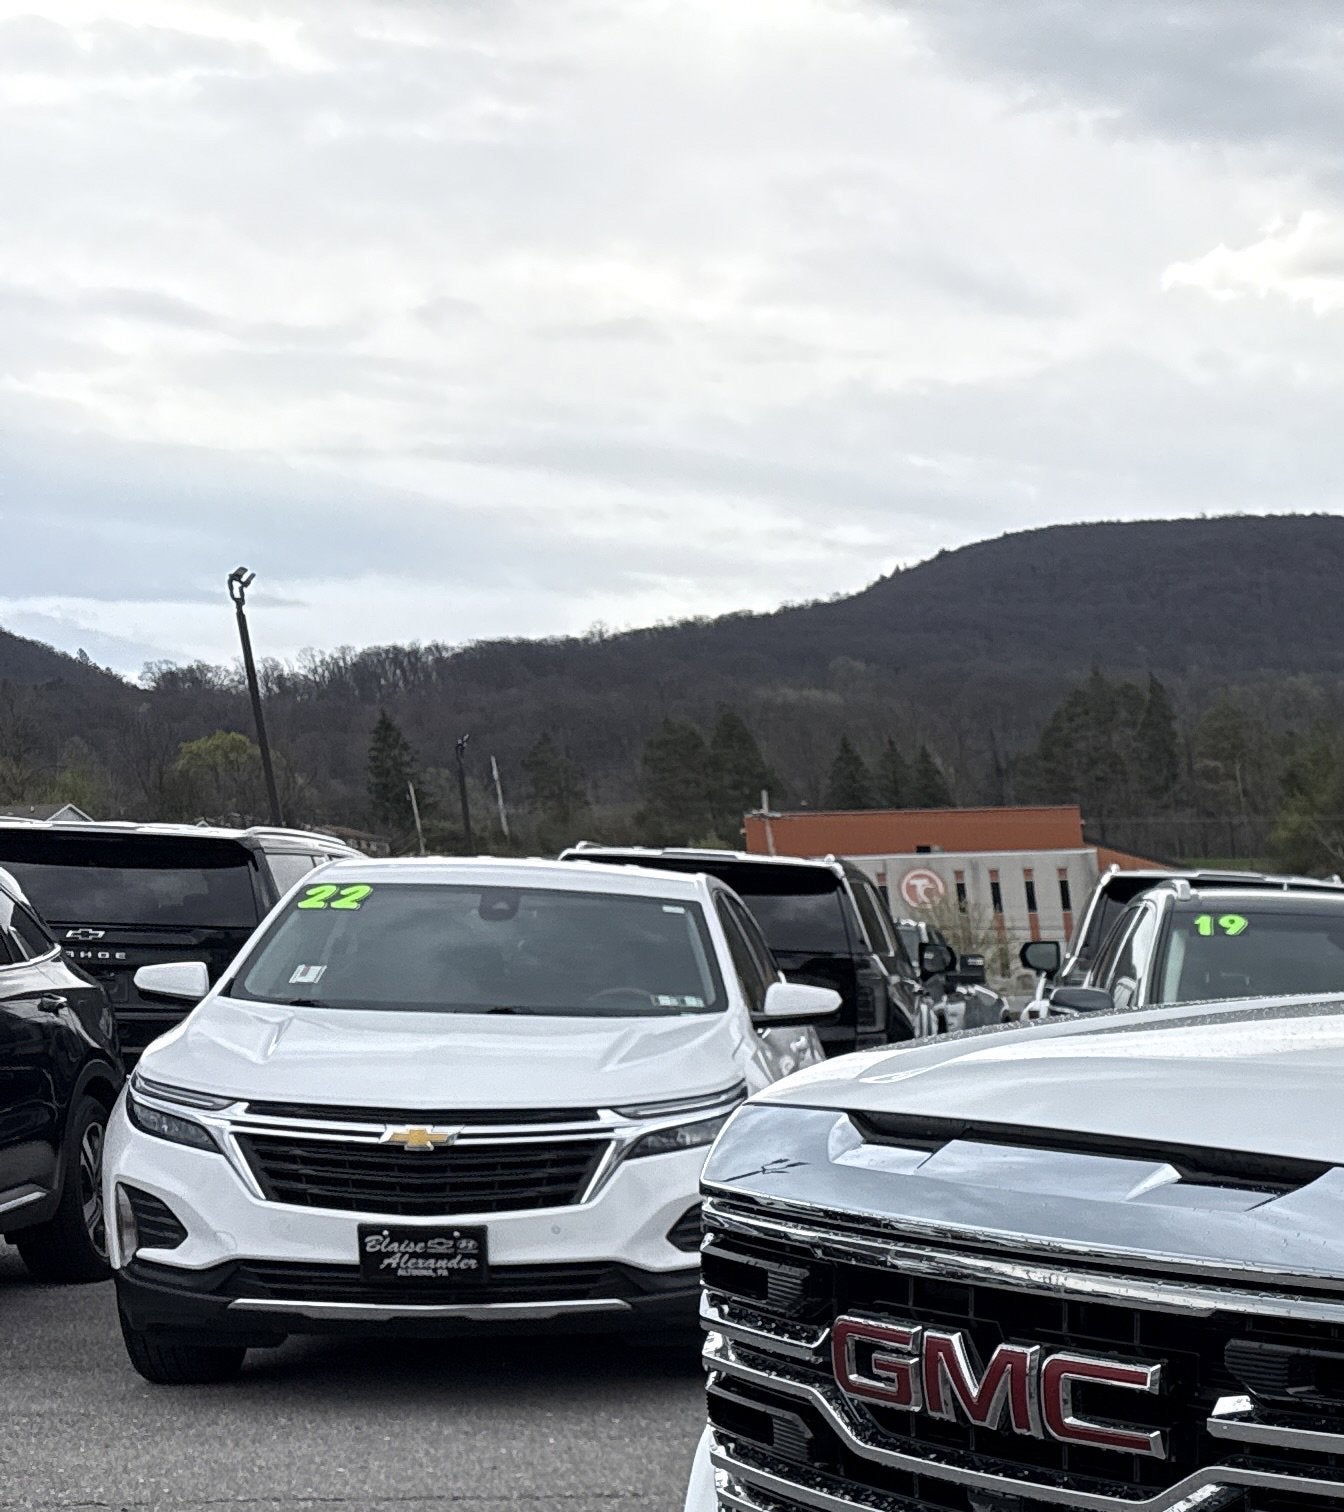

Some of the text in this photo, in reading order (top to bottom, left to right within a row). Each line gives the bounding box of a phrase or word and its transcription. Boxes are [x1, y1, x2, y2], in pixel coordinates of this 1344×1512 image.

[297, 884, 374, 910] 22
[1193, 914, 1249, 936] 19
[364, 1235, 426, 1253] Blaise
[379, 1252, 479, 1270] Alexander
[831, 1314, 1167, 1460] GMC
